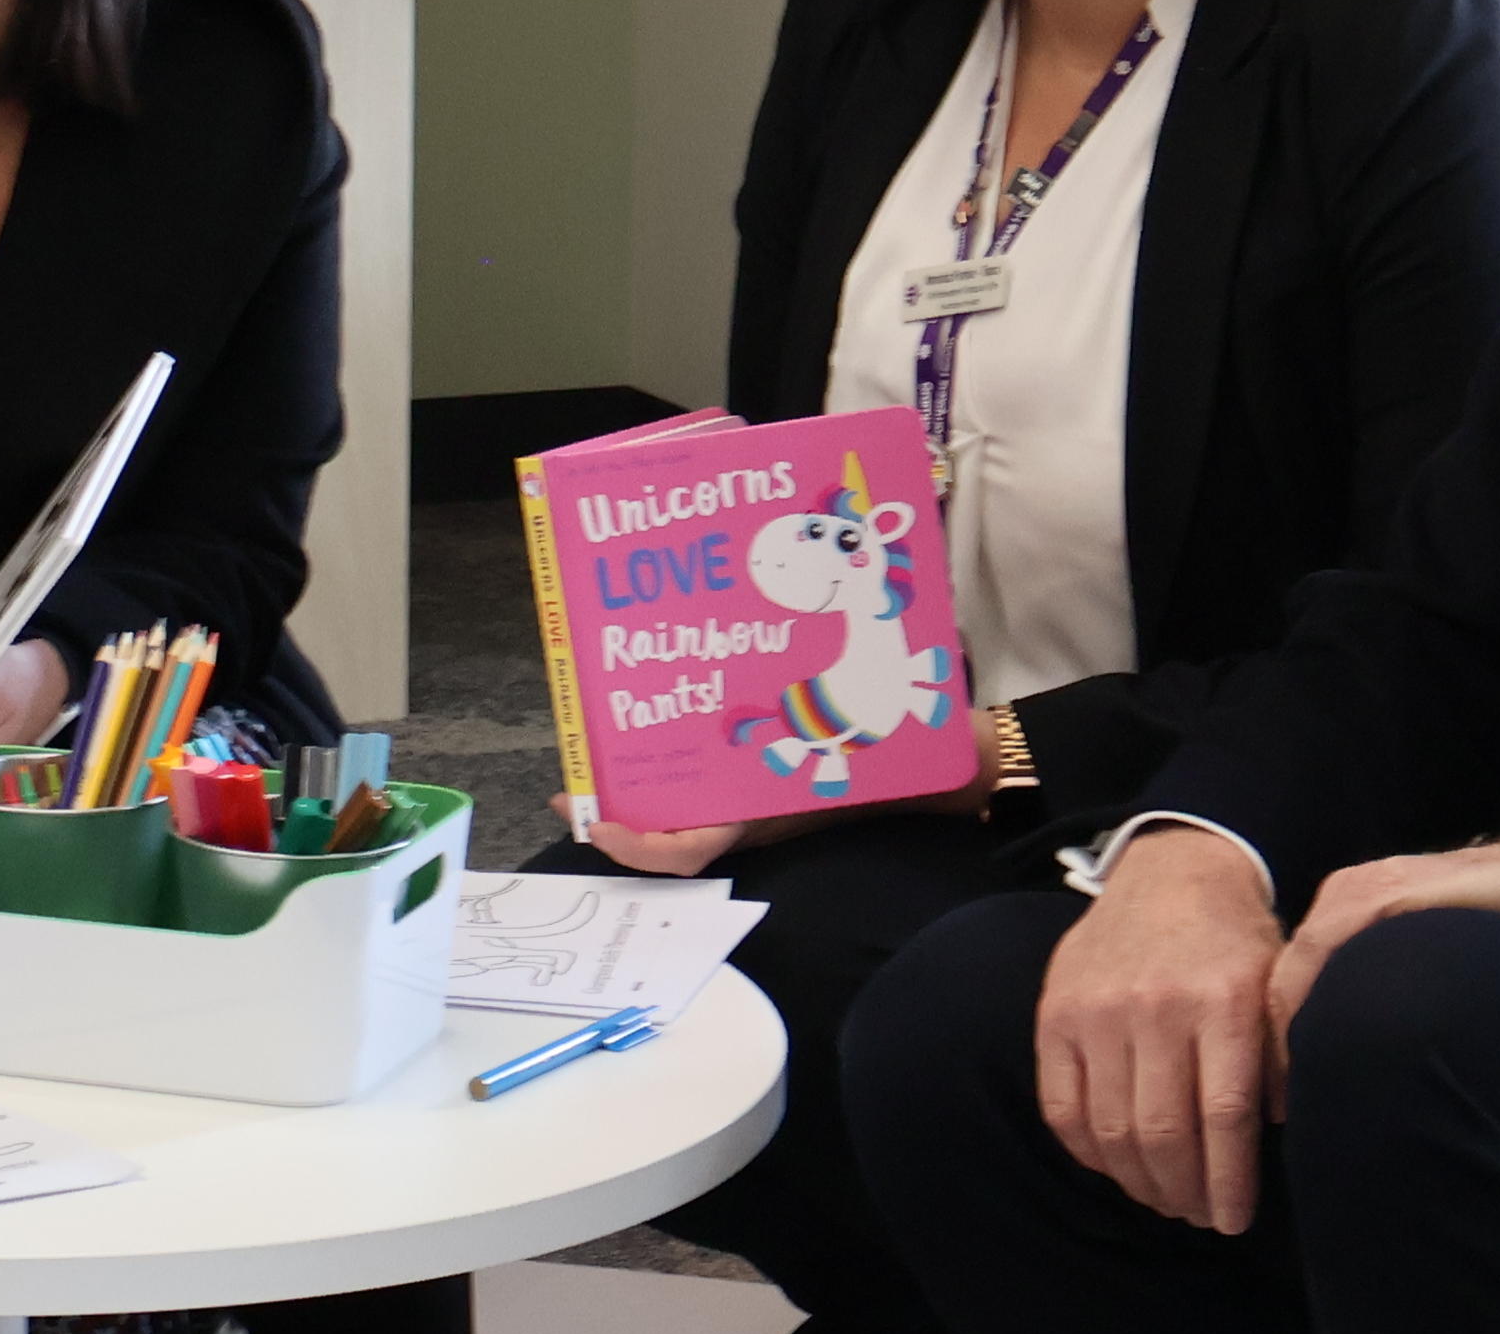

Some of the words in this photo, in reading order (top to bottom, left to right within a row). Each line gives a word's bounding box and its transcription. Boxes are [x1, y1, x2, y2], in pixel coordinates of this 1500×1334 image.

[577, 461, 797, 543] Unicorns
[596, 531, 735, 610] LOVE
[544, 599, 568, 648] LOVE
[602, 617, 798, 671] Rainbow
[608, 669, 725, 731] Pants!
